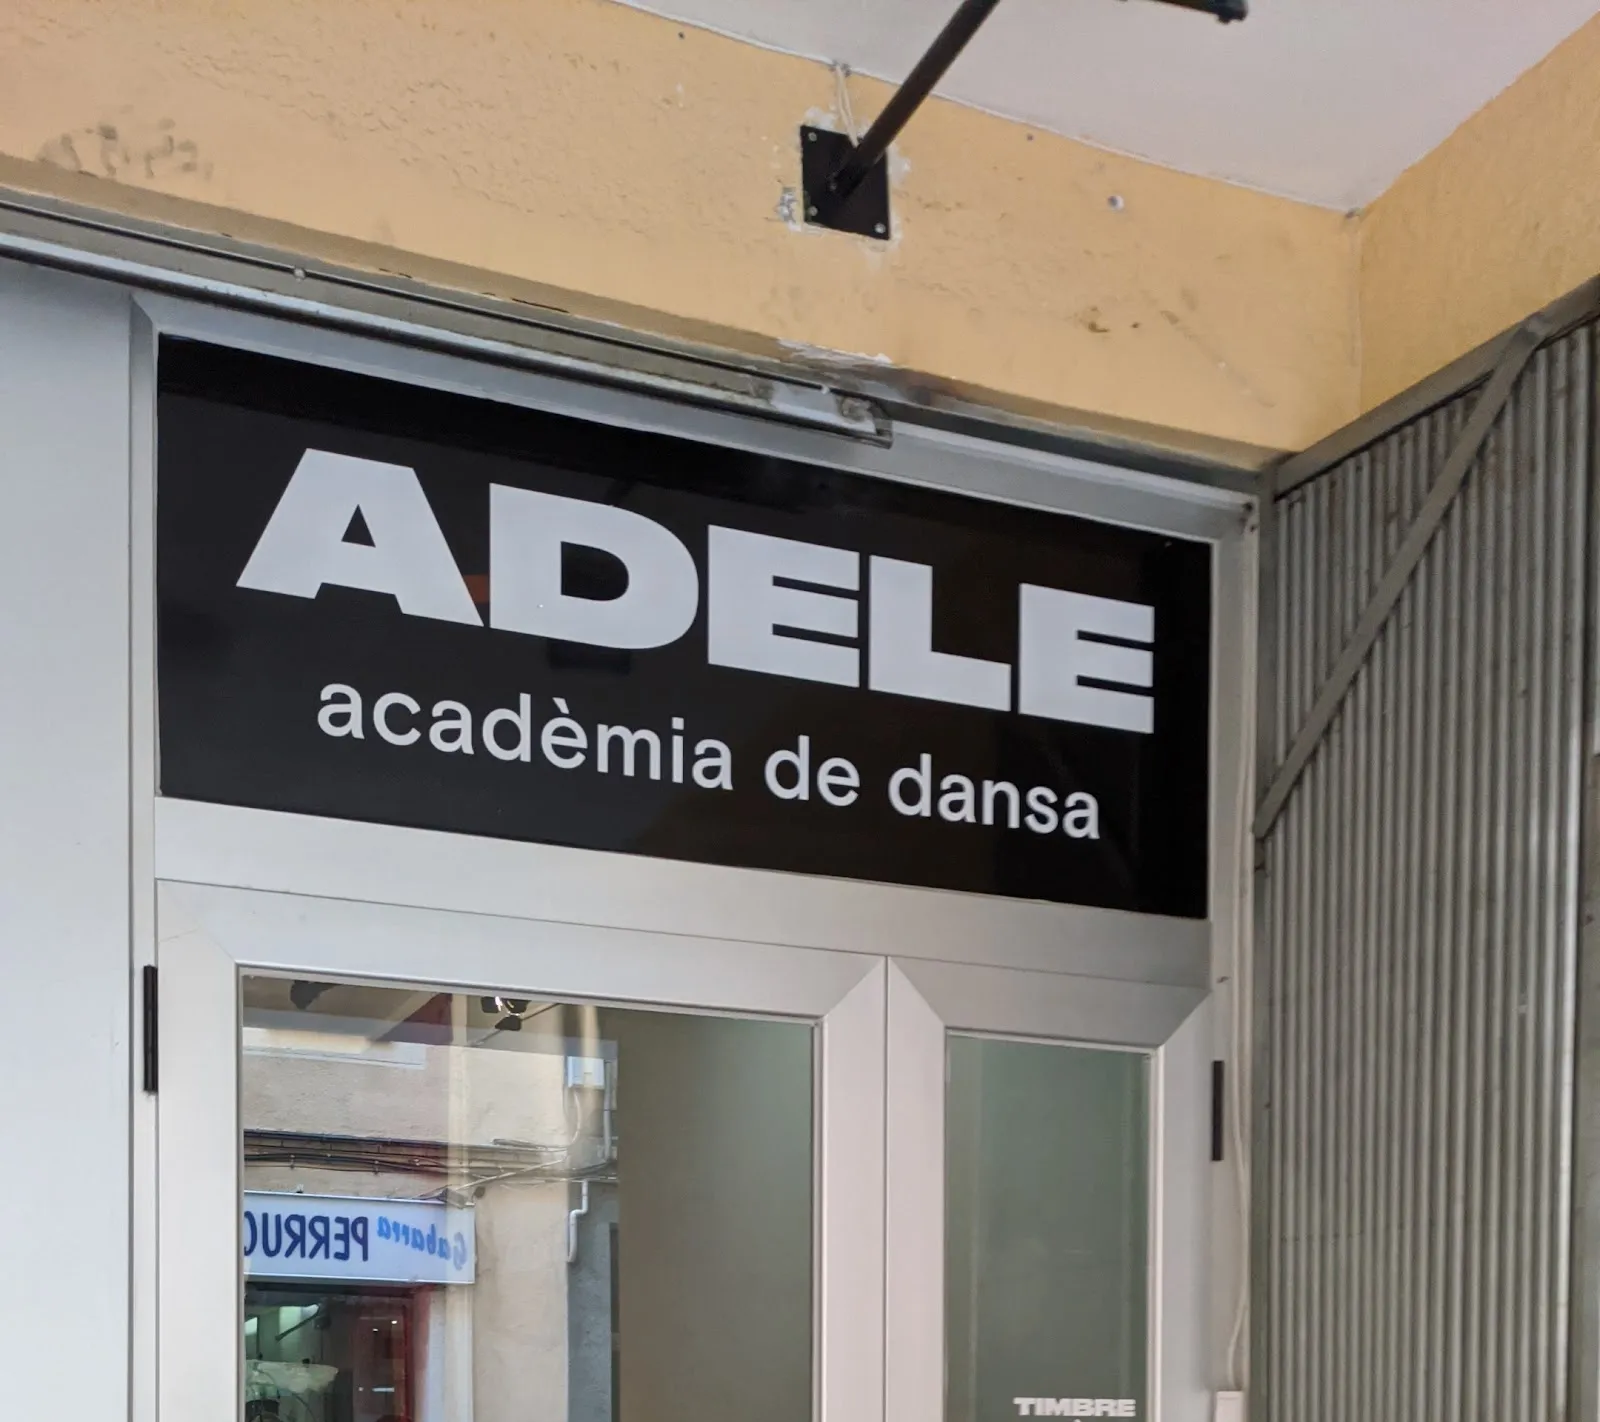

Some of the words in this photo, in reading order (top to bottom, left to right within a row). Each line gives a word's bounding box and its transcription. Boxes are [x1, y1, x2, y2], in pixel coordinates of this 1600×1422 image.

[236, 448, 1155, 734] ADELE
[317, 683, 734, 791] acadèmia
[764, 734, 860, 807] de
[888, 752, 1101, 839] dansa
[1012, 1396, 1137, 1418] TIMBRE
